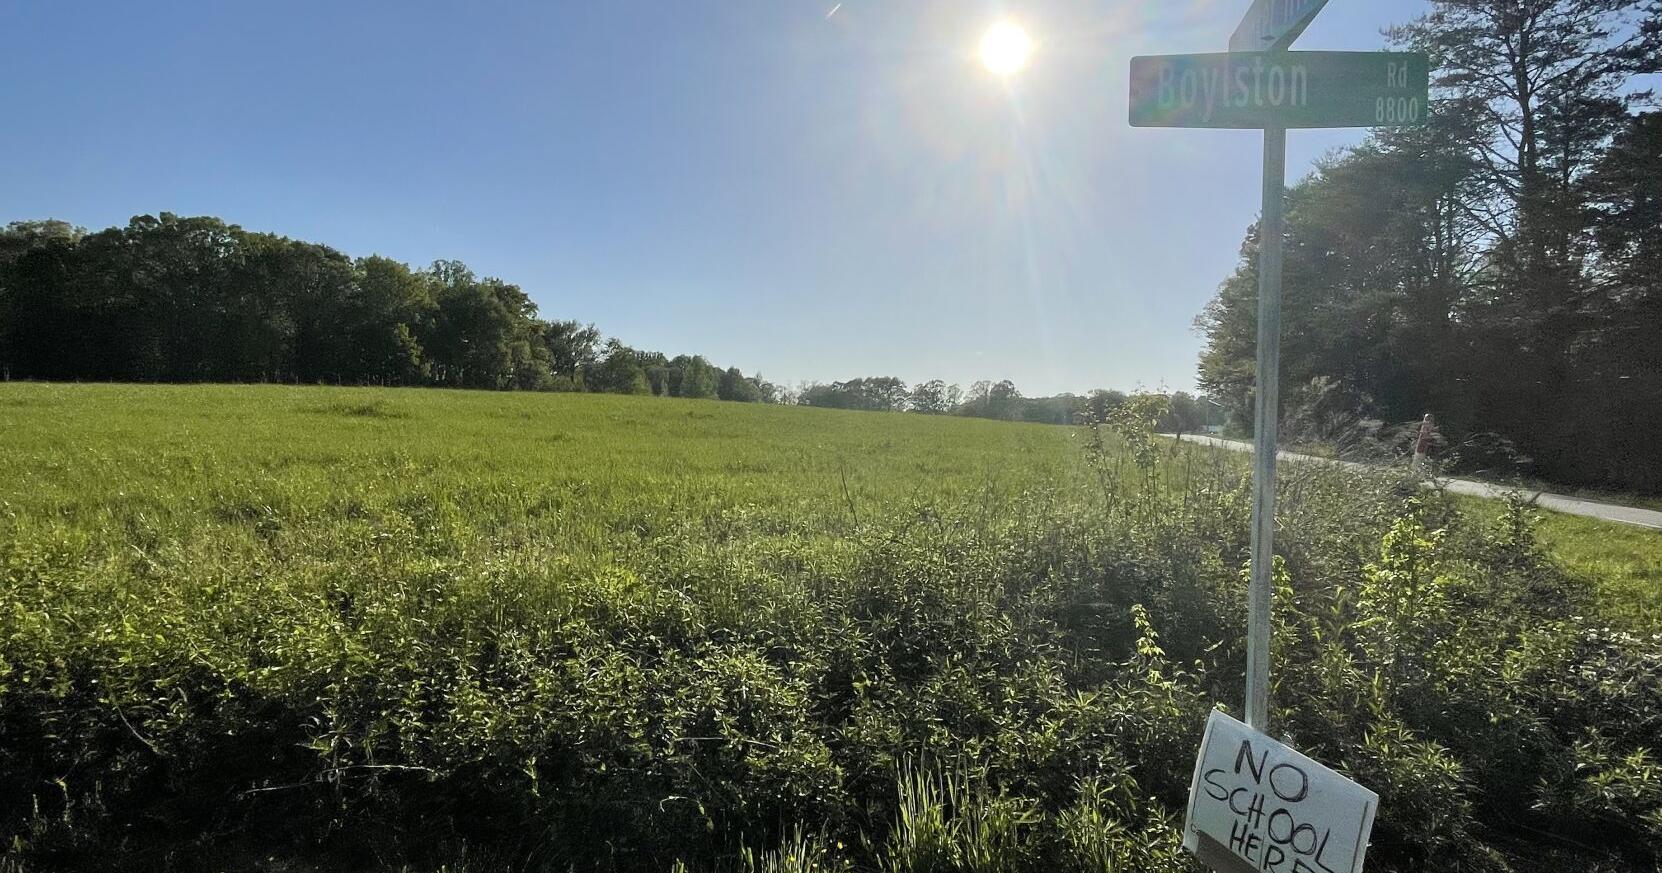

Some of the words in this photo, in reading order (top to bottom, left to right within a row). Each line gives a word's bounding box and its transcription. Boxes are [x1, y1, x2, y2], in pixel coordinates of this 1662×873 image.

[1158, 55, 1308, 122] Boylston
[1387, 60, 1408, 88] Rd
[1375, 96, 1418, 122] 8800
[1235, 739, 1309, 803] NO
[1204, 768, 1335, 873] SCHOOL
